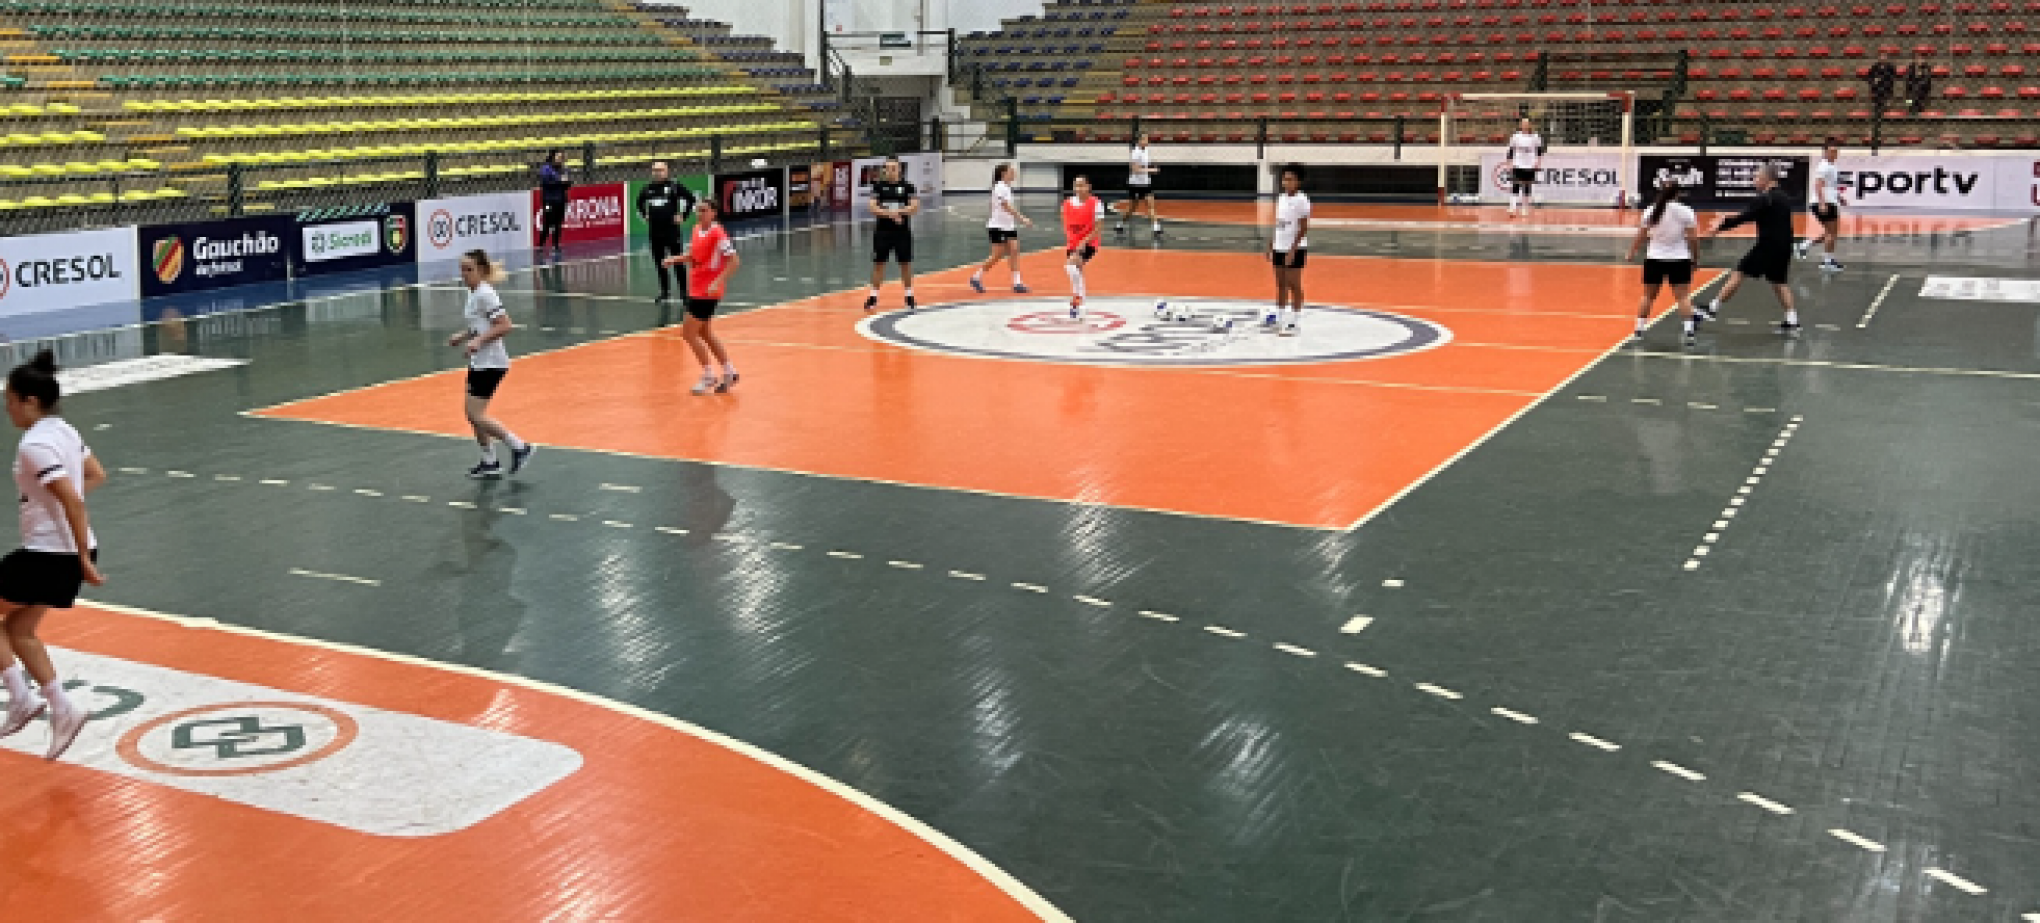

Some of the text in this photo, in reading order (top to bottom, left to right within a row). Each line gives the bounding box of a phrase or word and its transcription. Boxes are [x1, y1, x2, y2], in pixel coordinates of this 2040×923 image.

[1534, 168, 1622, 187] CRESOL
[455, 211, 522, 237] CRESOL
[193, 231, 279, 260] Gauchão
[15, 253, 122, 288] CRESOL
